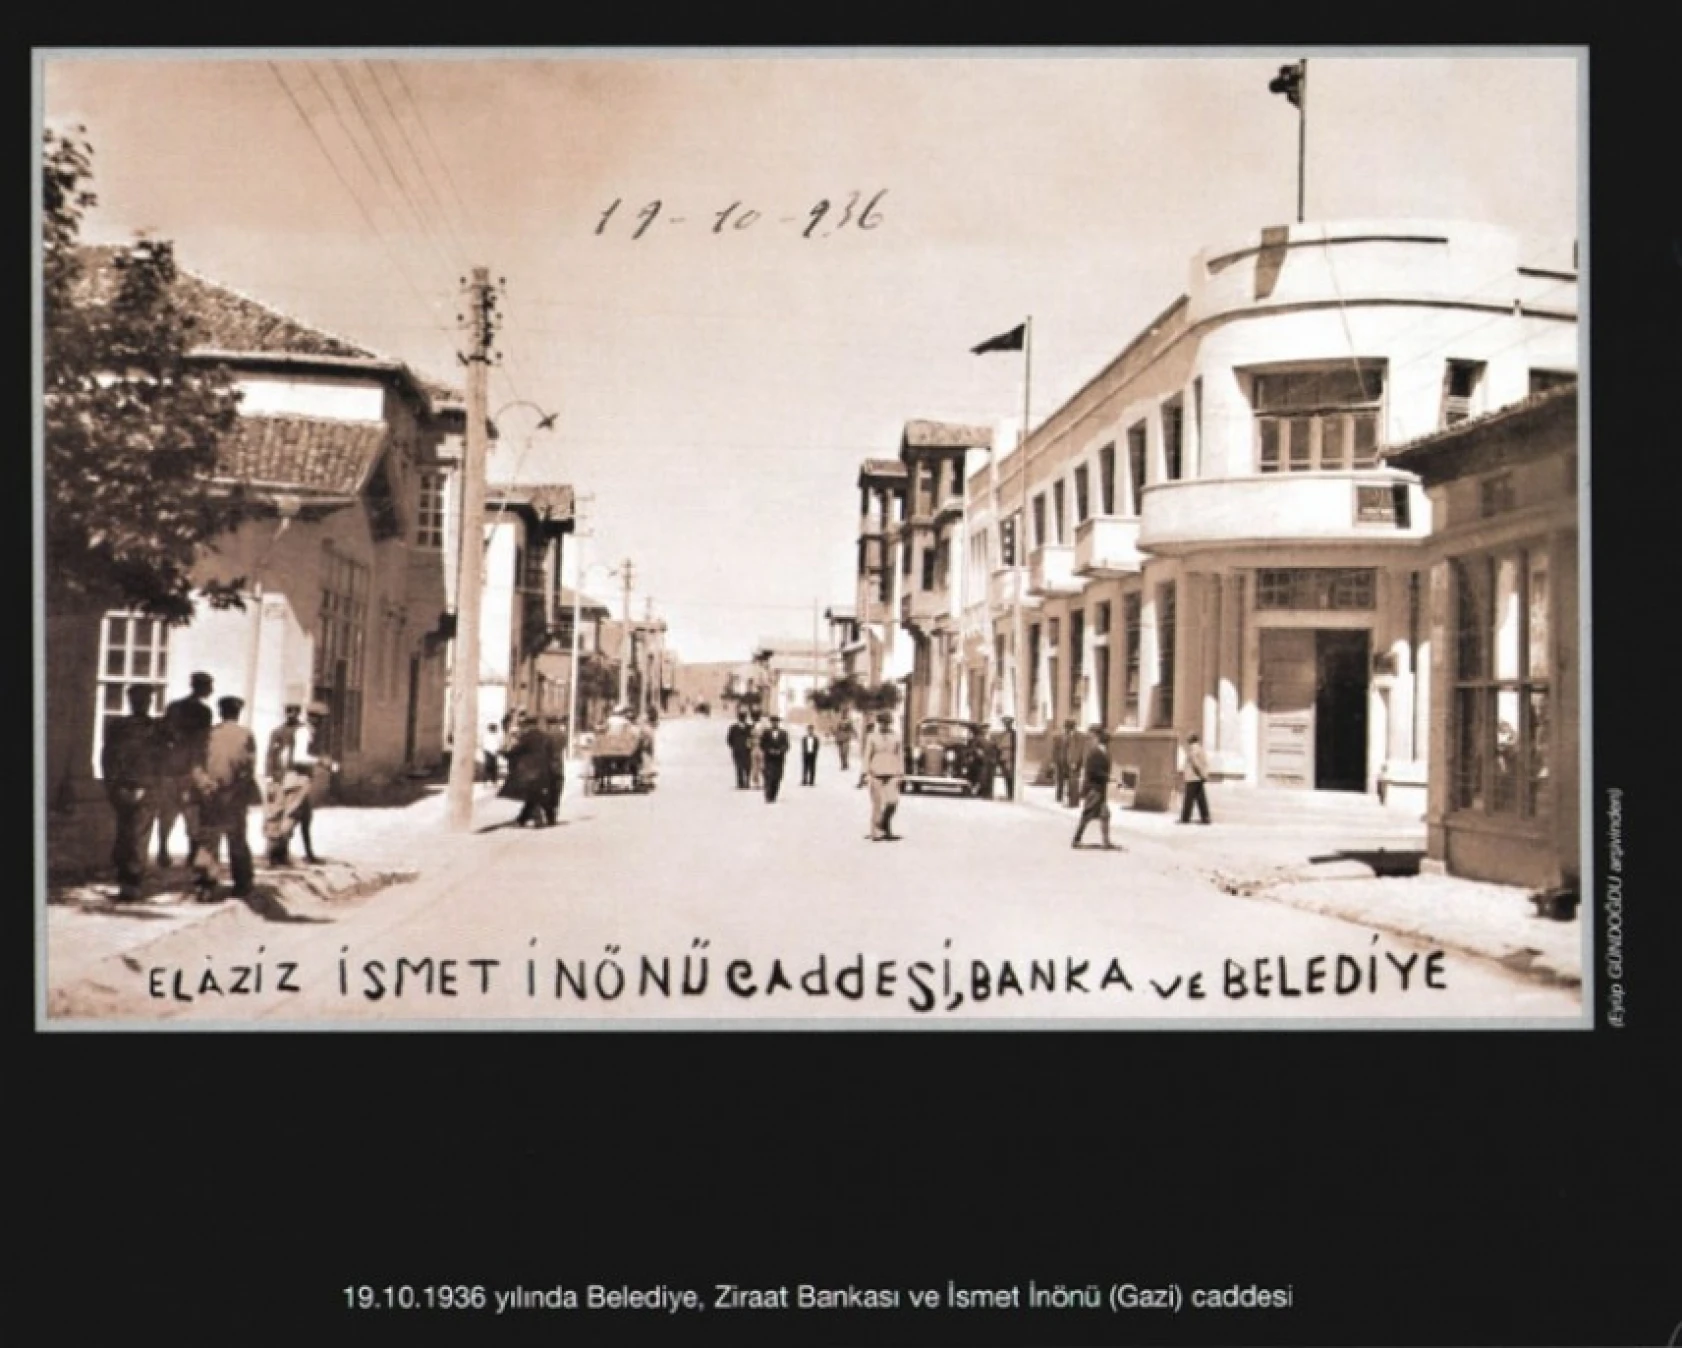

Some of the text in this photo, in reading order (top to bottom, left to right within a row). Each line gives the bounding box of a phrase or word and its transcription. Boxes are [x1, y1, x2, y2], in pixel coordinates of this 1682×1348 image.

[339, 945, 501, 1001] İSMET
[527, 937, 711, 1001] İNÖNÜ
[1223, 937, 1448, 999] BELEDİYE
